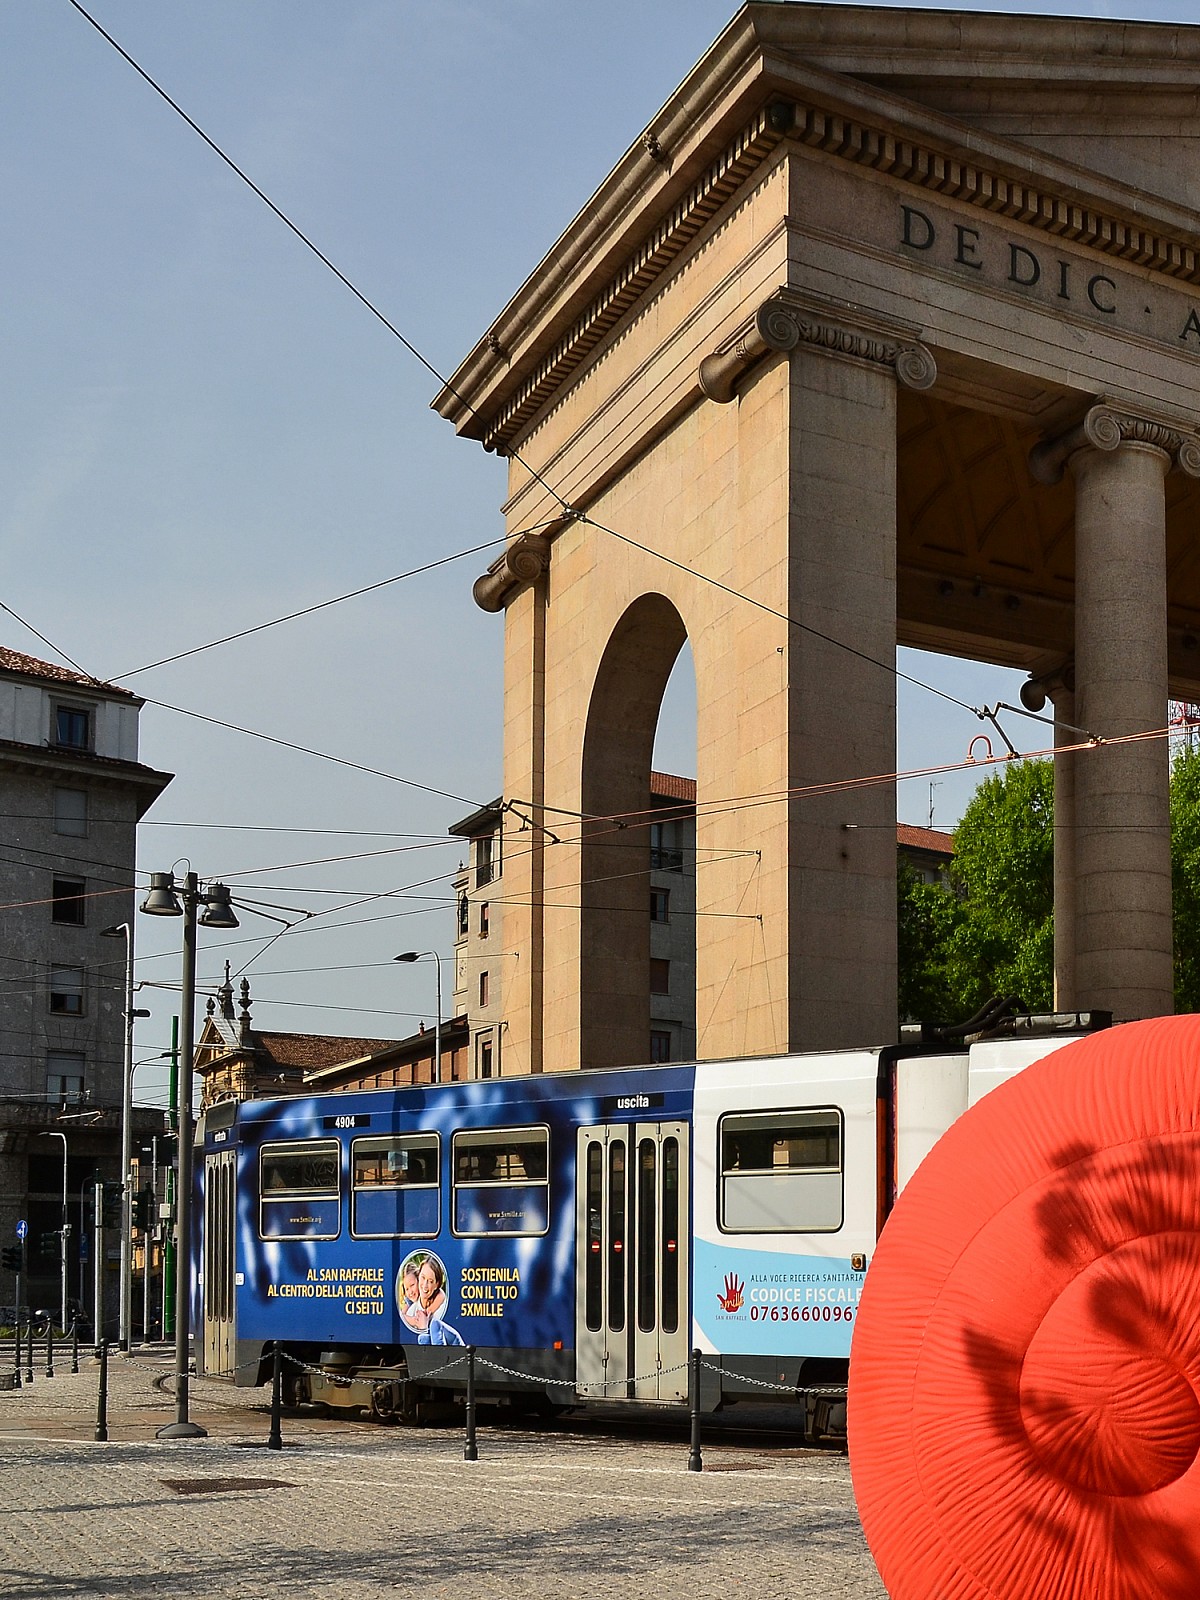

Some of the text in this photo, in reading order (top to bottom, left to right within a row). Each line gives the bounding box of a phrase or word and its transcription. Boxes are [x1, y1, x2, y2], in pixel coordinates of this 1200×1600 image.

[900, 204, 1117, 314] DEDIC
[617, 1094, 650, 1109] uscita
[335, 1116, 356, 1128] 4904
[306, 1268, 384, 1282] AL SAN RAFFAELE
[461, 1267, 520, 1282] SOSTIENILA
[750, 1273, 863, 1282] ALLA VOCE RICERCA SANITARIA
[267, 1284, 384, 1298] AL CENTRO DELLA RICERCA
[460, 1285, 518, 1300] CON IL TUO
[750, 1287, 801, 1302] CODICE
[345, 1301, 384, 1315] CI SEI TU
[460, 1302, 504, 1317] 5XMILLE
[750, 1305, 859, 1322] 0763660096
